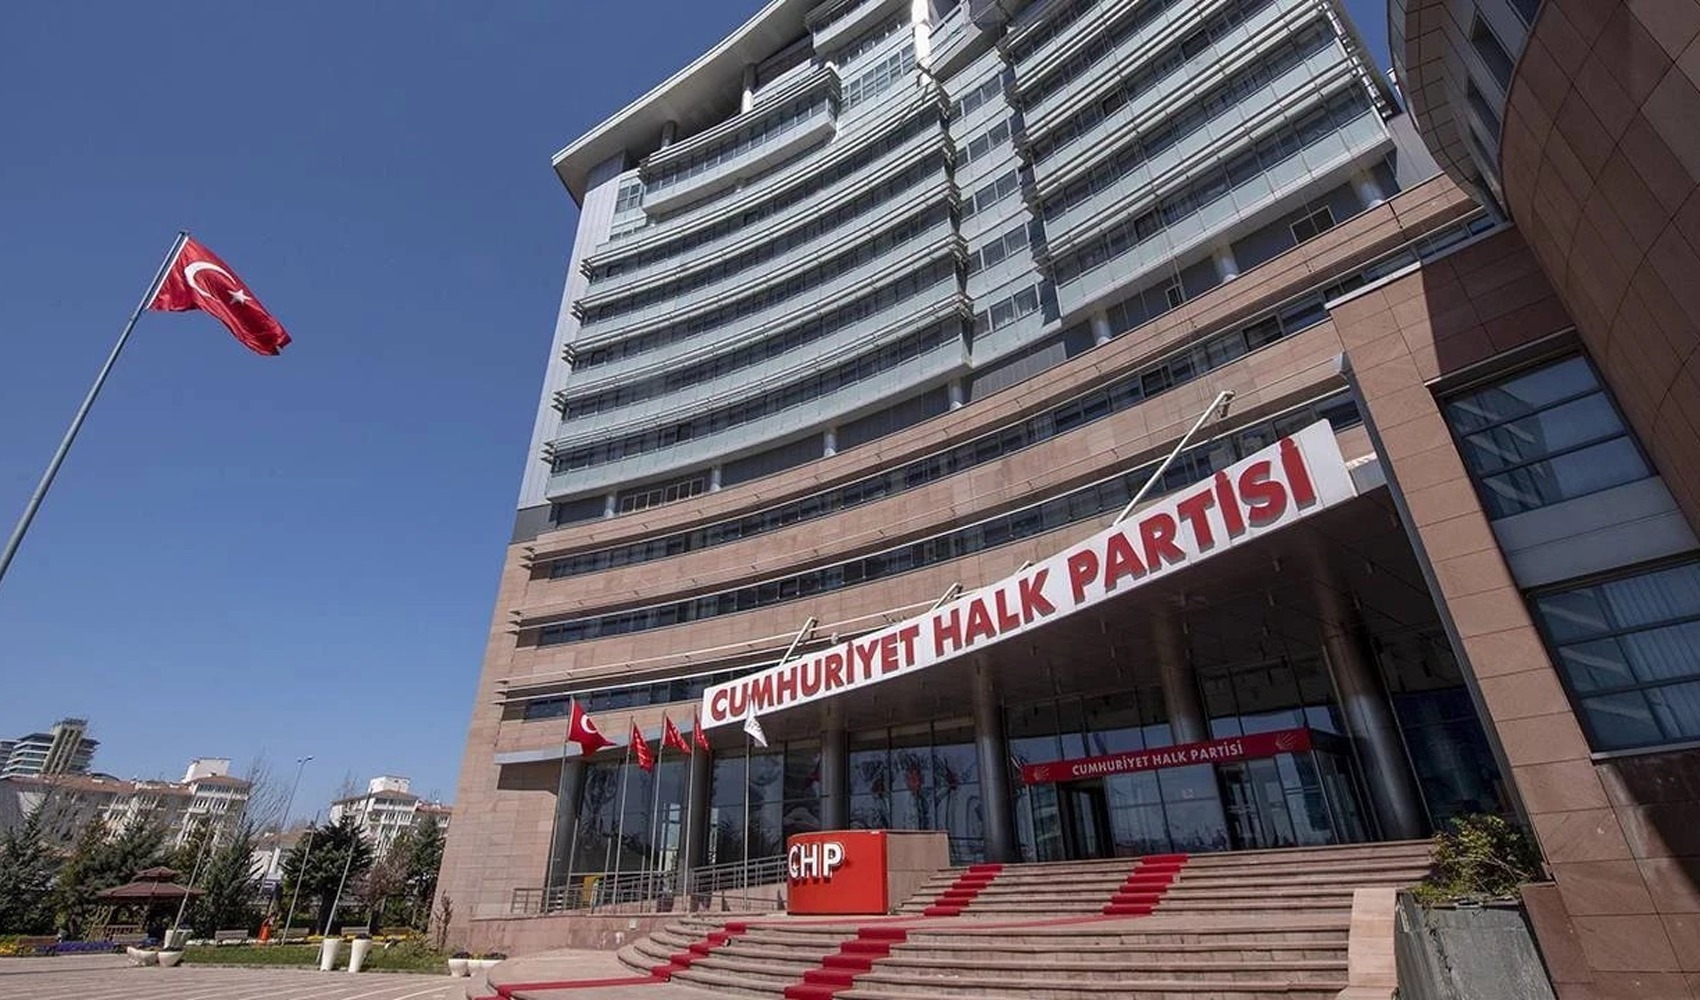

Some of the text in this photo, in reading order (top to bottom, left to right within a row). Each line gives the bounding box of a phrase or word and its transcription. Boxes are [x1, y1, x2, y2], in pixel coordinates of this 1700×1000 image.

[711, 436, 1317, 722] CUMHURİYET HALK PARTİSİ
[1072, 740, 1244, 776] CUMHURİYET HALK PARTİSİ
[788, 841, 845, 879] CHP
